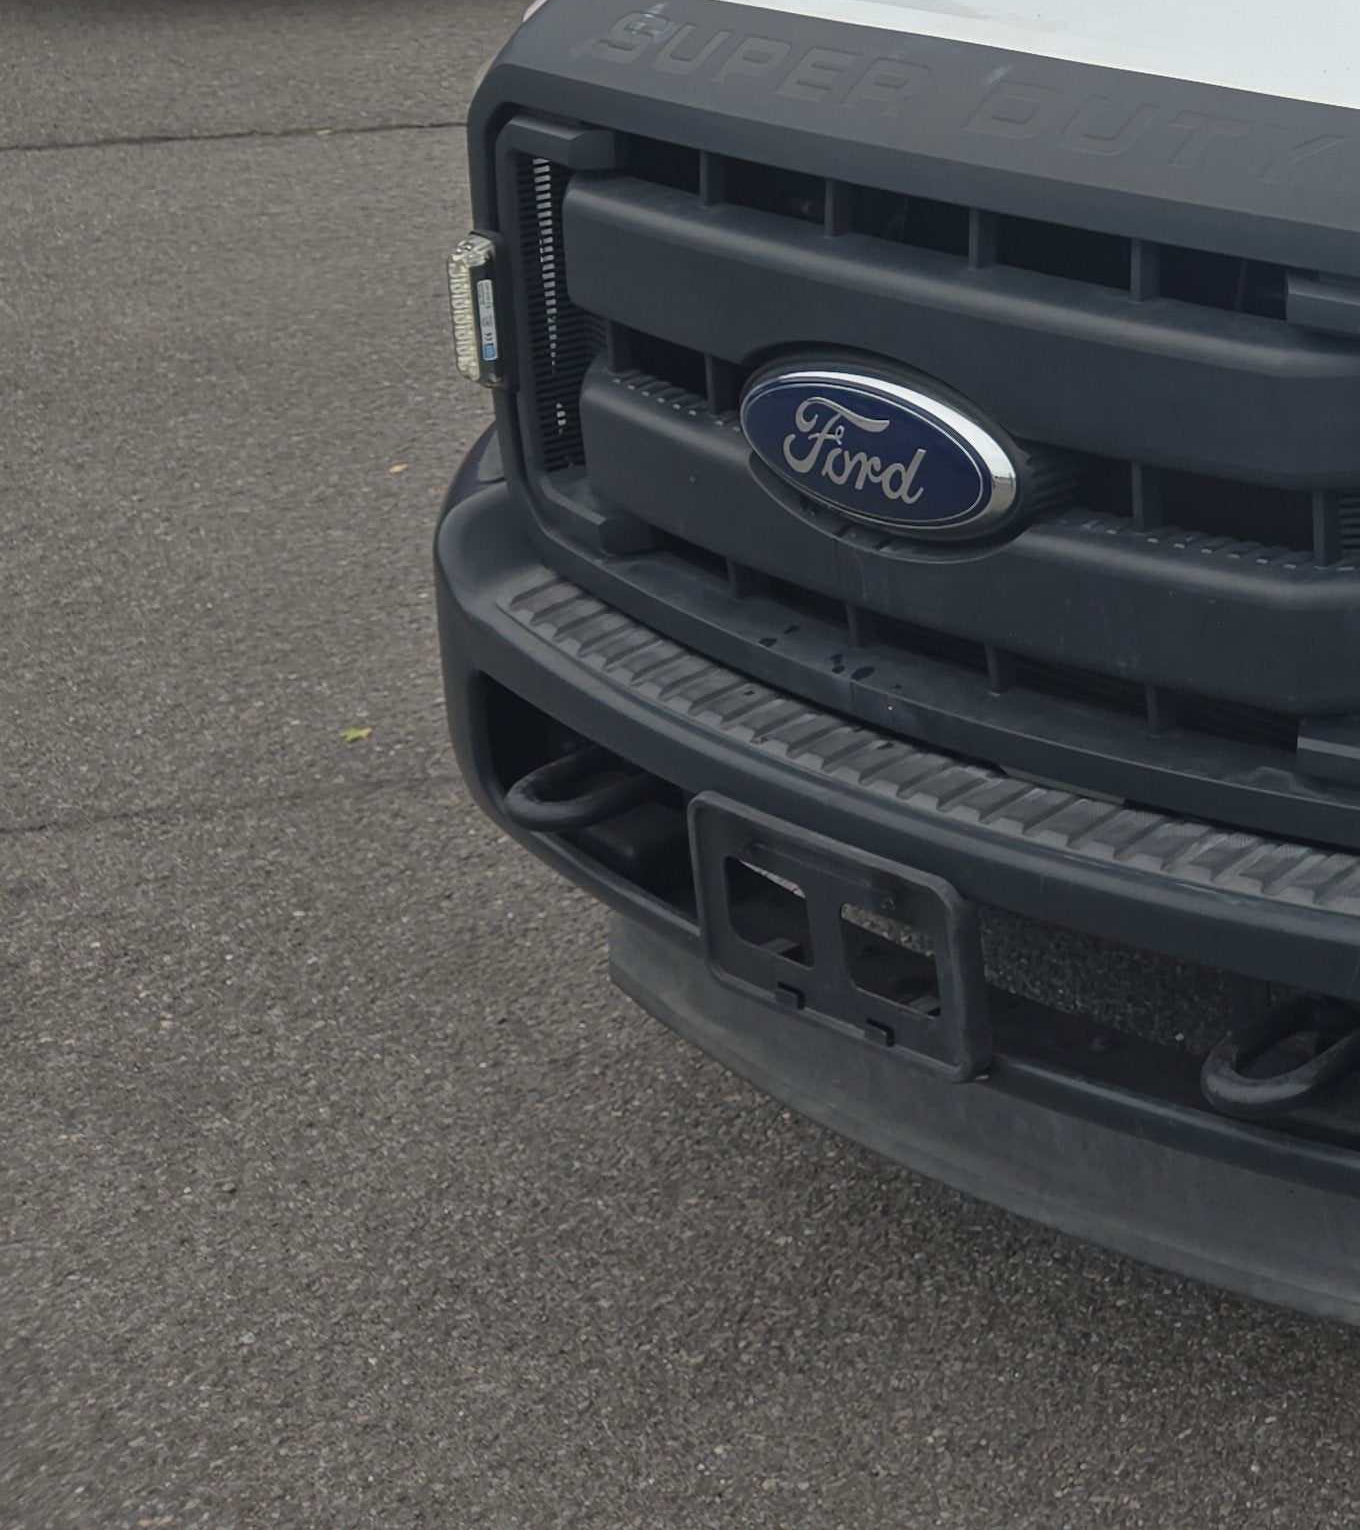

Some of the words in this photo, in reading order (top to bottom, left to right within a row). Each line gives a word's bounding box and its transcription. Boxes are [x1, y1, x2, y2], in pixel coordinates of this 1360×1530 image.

[592, 7, 931, 117] SUPER
[963, 80, 1346, 186] DUTY
[783, 396, 926, 505] Ford
